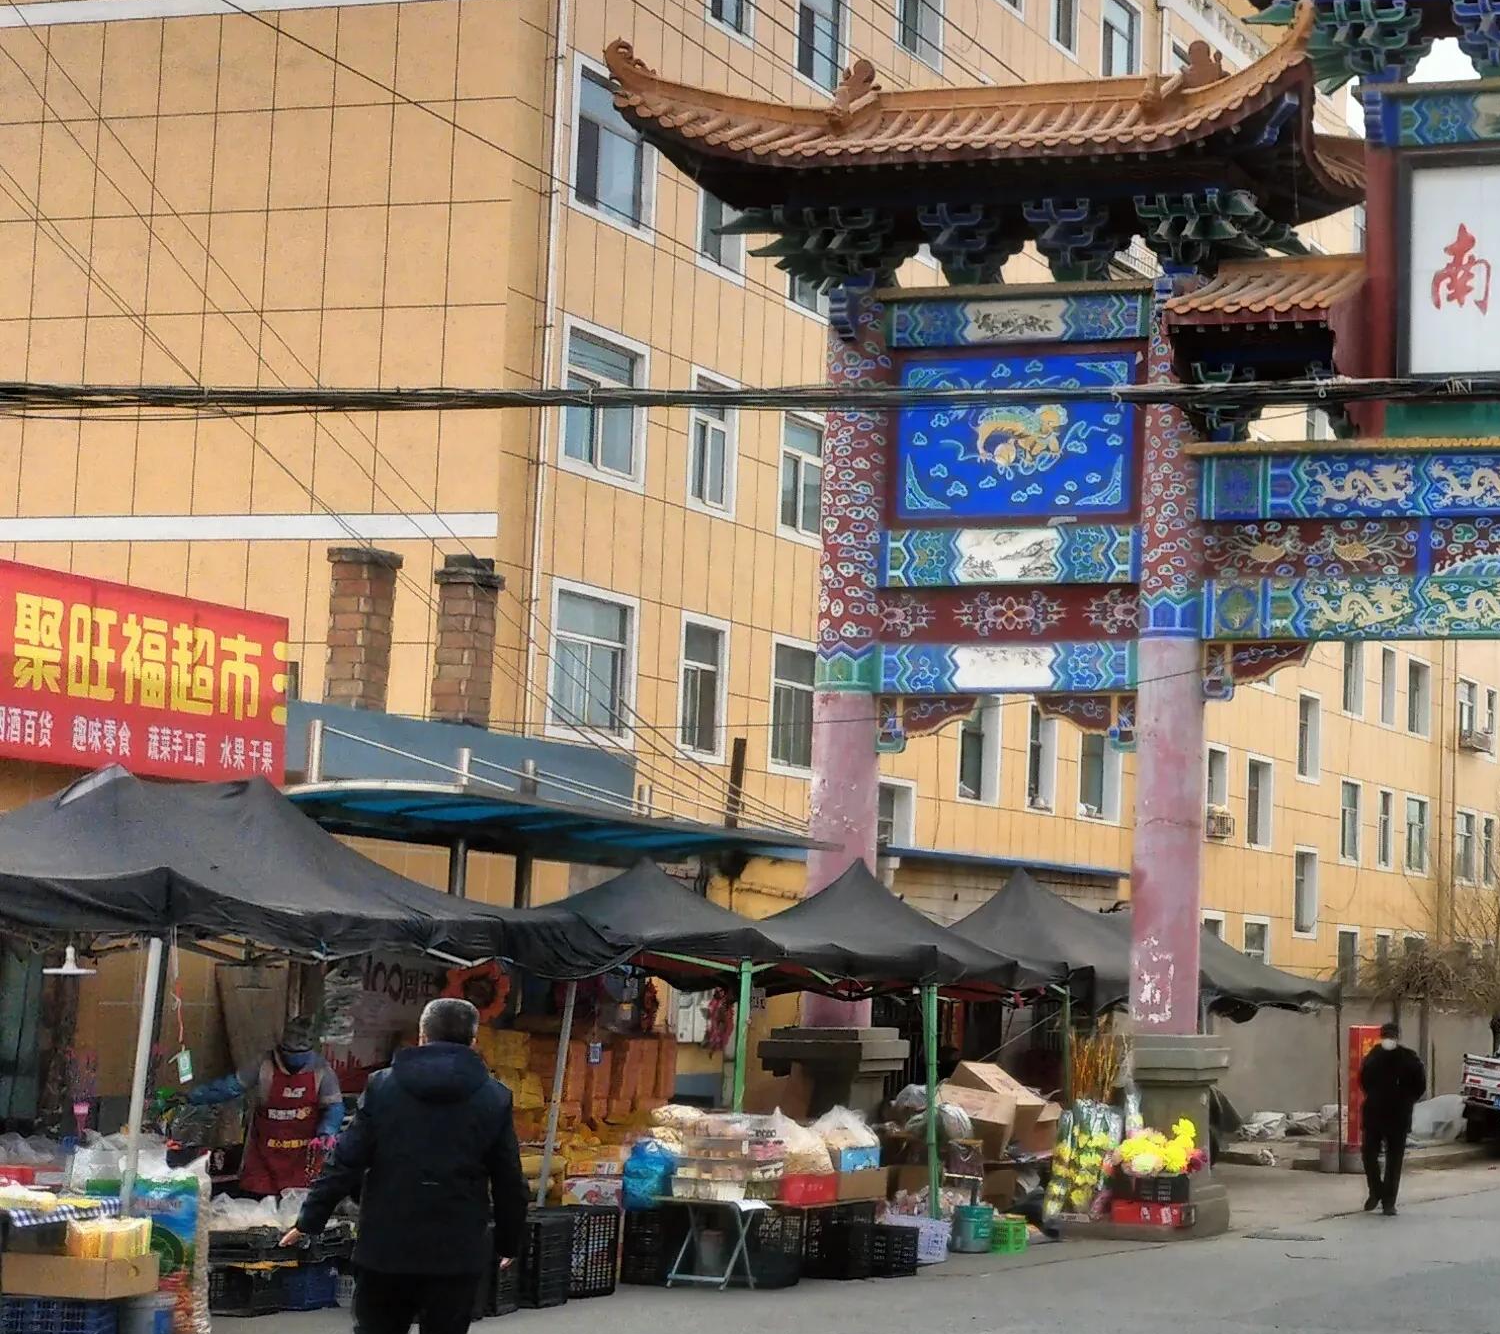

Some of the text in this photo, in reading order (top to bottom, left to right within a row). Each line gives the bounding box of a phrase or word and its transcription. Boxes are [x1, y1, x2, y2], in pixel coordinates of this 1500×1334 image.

[13, 591, 262, 721] 聚旺福超市
[72, 714, 132, 757] 趣味零食
